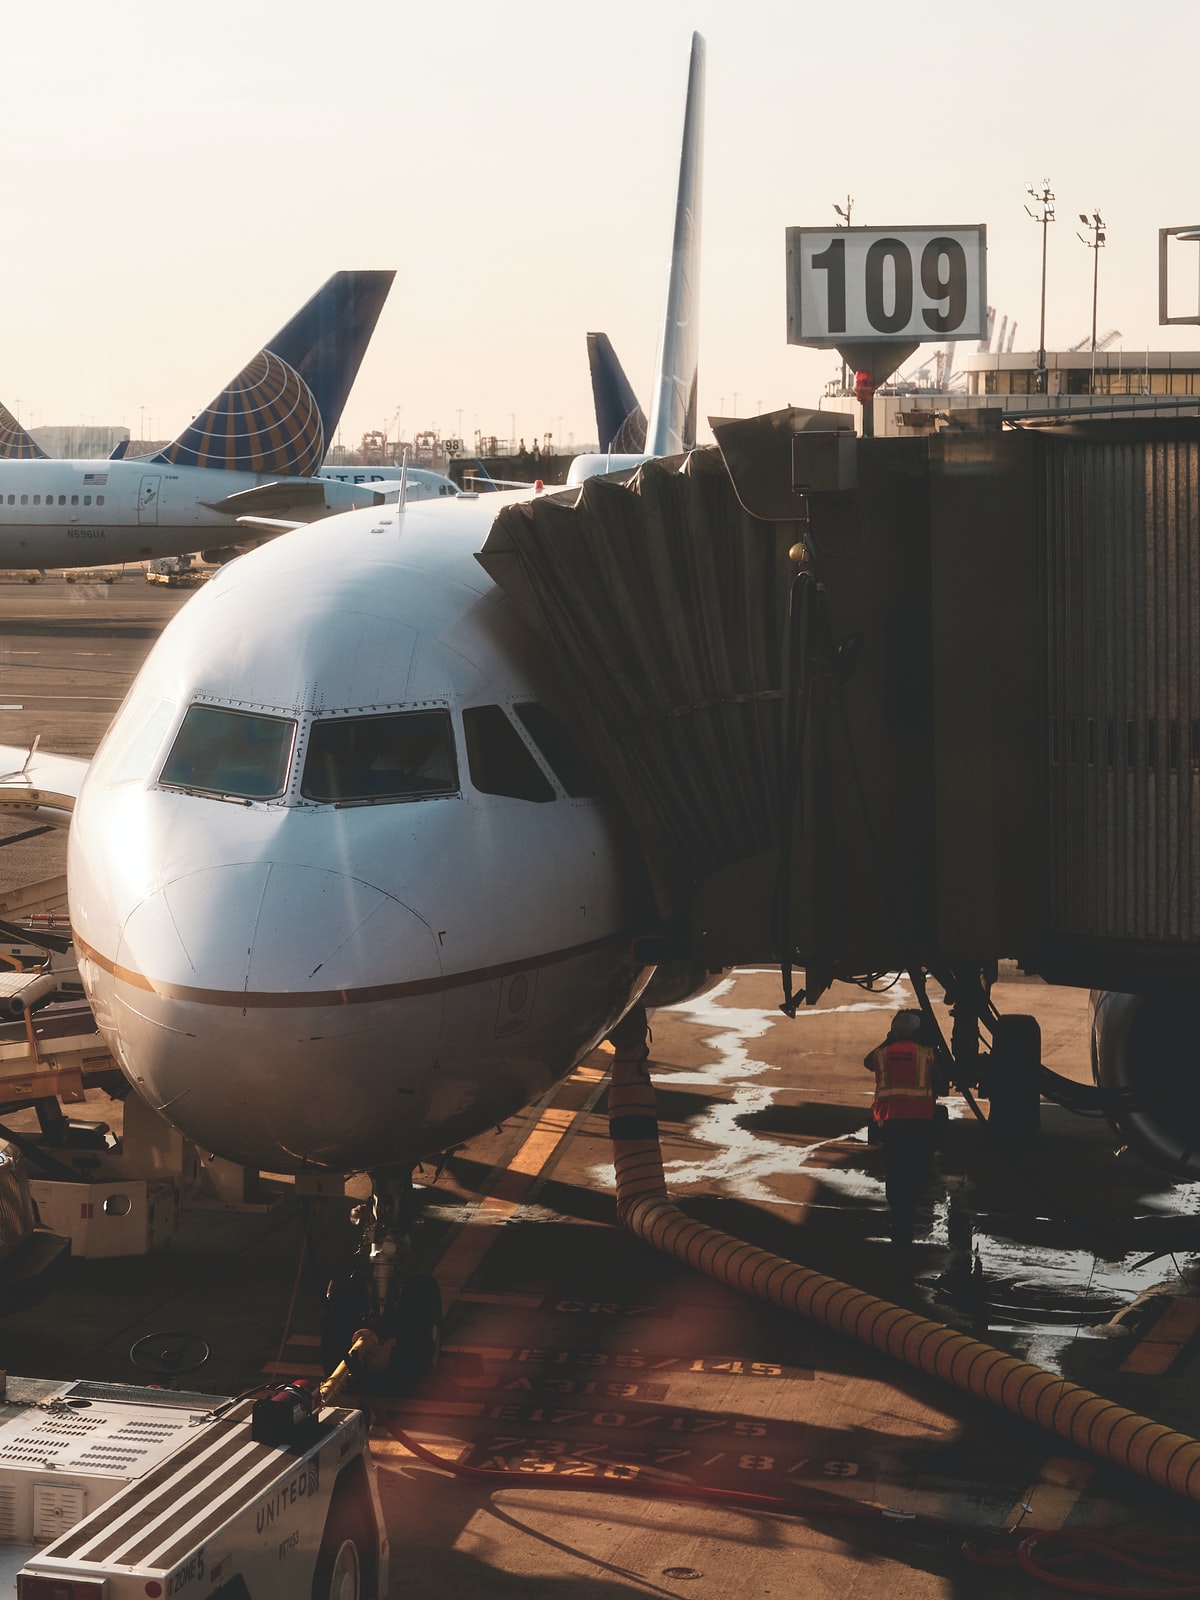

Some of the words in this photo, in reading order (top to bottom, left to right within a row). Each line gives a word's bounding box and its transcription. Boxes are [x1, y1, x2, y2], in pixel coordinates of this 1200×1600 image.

[811, 236, 968, 334] 109
[445, 439, 459, 450] 98
[503, 1375, 640, 1398] A319
[493, 1405, 769, 1438] E170/175
[479, 1455, 641, 1480] A320
[256, 1473, 307, 1533] UNITED
[174, 1557, 197, 1594] ZONE
[197, 1548, 205, 1582] 5
